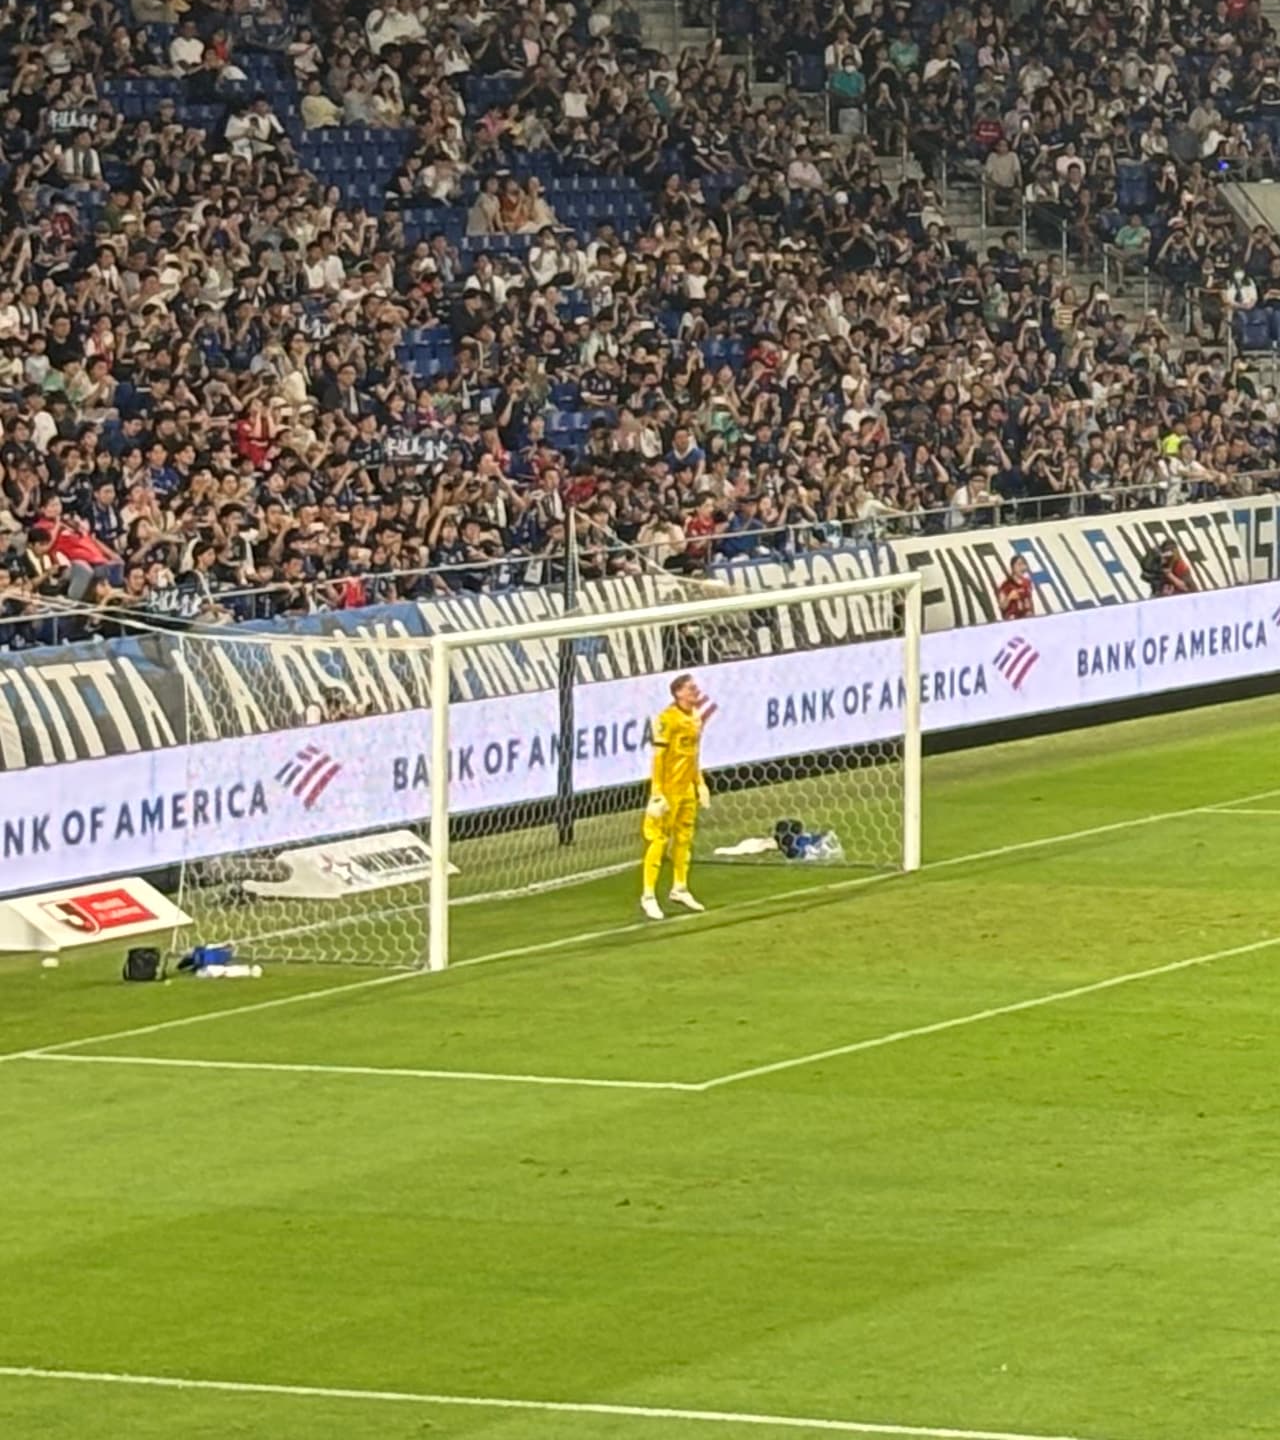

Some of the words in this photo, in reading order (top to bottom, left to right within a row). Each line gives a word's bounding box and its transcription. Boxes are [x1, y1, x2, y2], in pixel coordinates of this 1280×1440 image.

[1009, 528, 1145, 615] ALLA
[1077, 639, 1136, 677] BANK
[1142, 635, 1169, 665] OF
[1174, 619, 1268, 662] AMERICA
[766, 688, 835, 729] BANK
[843, 682, 873, 713] OF
[392, 744, 475, 791] BAK
[483, 739, 520, 775] OF
[62, 807, 106, 845] OF
[114, 780, 268, 839] AMERICA
